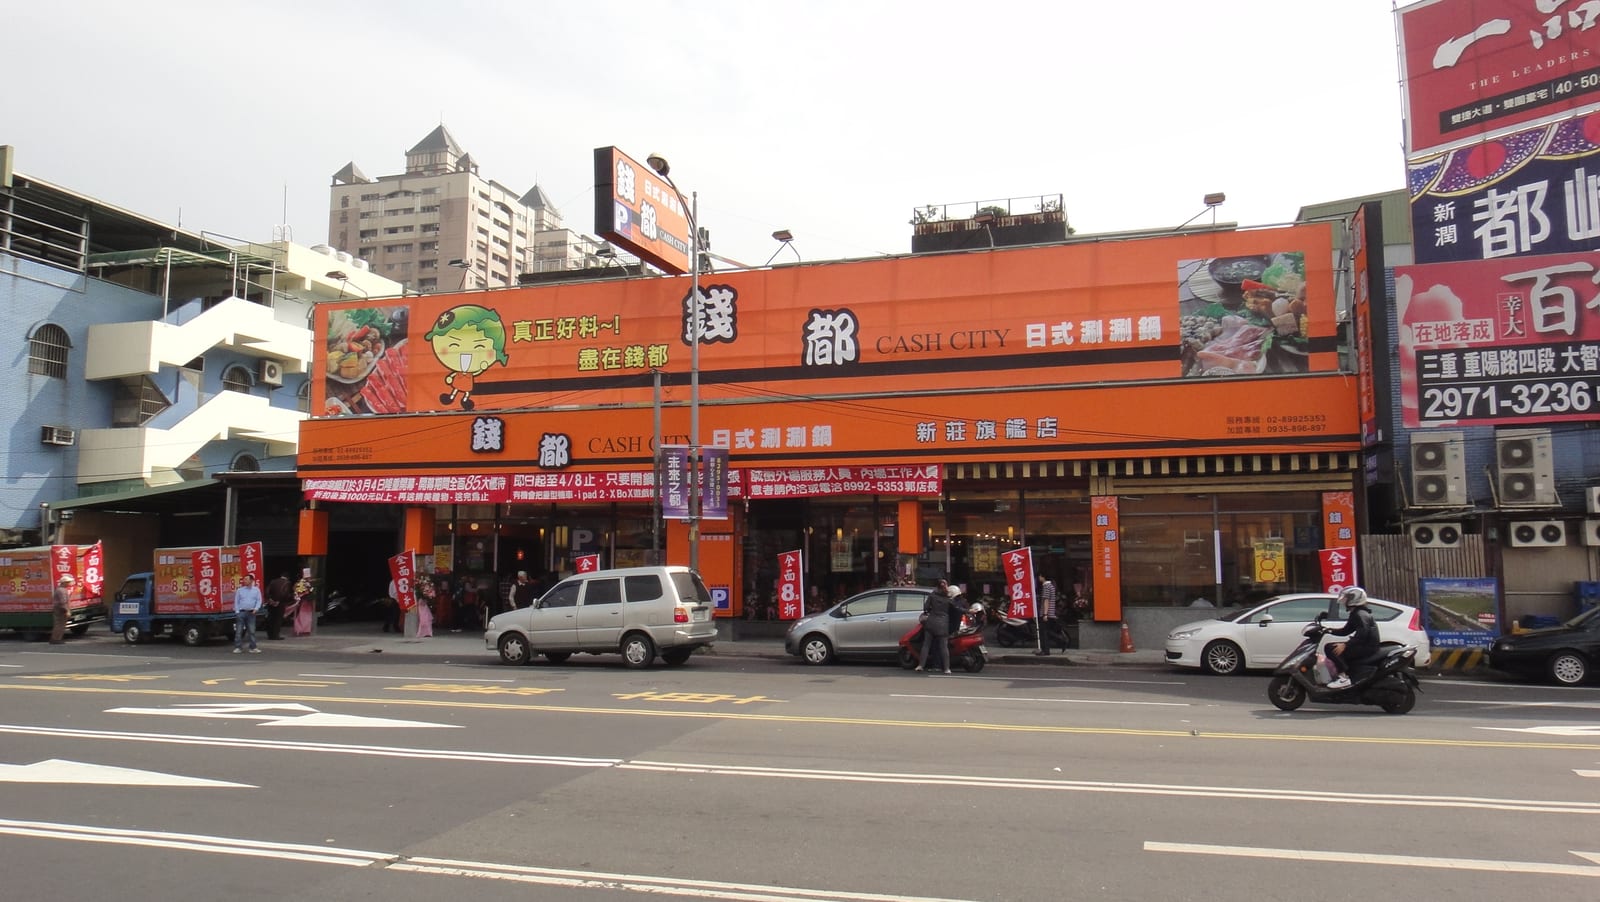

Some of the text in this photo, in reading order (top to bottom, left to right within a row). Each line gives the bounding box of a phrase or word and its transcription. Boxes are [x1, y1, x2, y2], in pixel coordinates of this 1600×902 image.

[1469, 48, 1591, 91] THE LEADERS
[1555, 72, 1600, 96] 40-50
[1434, 200, 1458, 247] 新潤
[1501, 261, 1600, 337] 百
[876, 332, 942, 355] CASH
[949, 328, 1011, 350] CITY
[1025, 315, 1163, 348] 日式涮涮鍋
[1415, 320, 1491, 344] 在地落成
[577, 344, 670, 371] 盡在錢都
[1422, 343, 1600, 379] 三重 重陽路四段 大智
[1423, 380, 1591, 418] 2971-3236
[588, 435, 642, 454] CASH
[712, 424, 834, 450] 日式涮涮鍋
[916, 417, 1058, 443] 新莊旗艦店
[580, 557, 592, 571] 全
[711, 588, 727, 608] P
